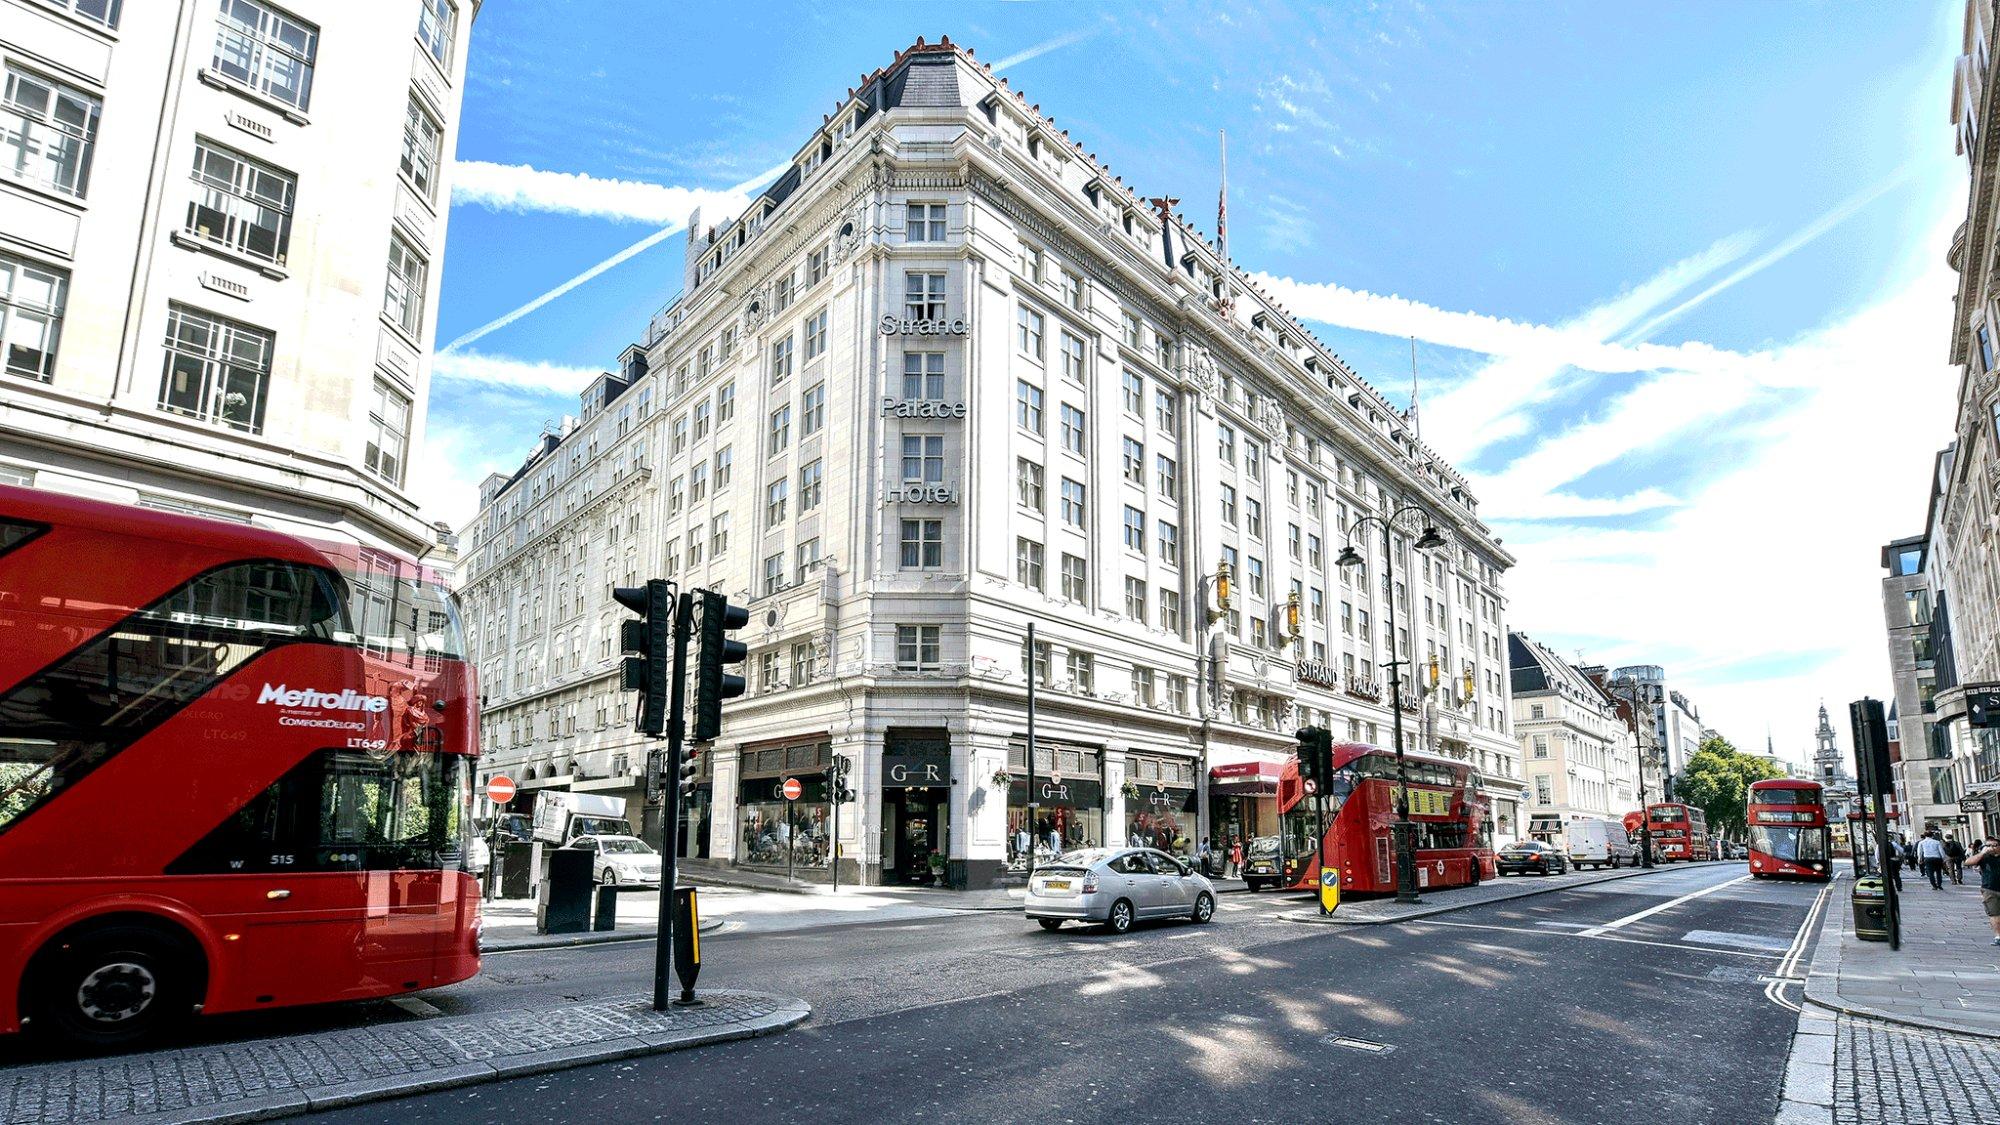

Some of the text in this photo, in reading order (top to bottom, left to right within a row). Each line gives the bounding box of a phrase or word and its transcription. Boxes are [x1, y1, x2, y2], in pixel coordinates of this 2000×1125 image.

[880, 312, 968, 335] Strand
[880, 396, 967, 418] Palace
[885, 481, 959, 504] Hotel
[1300, 660, 1338, 685] STRAND
[257, 682, 389, 713] Metroline
[347, 738, 386, 750] LT649
[269, 855, 295, 865] 515
